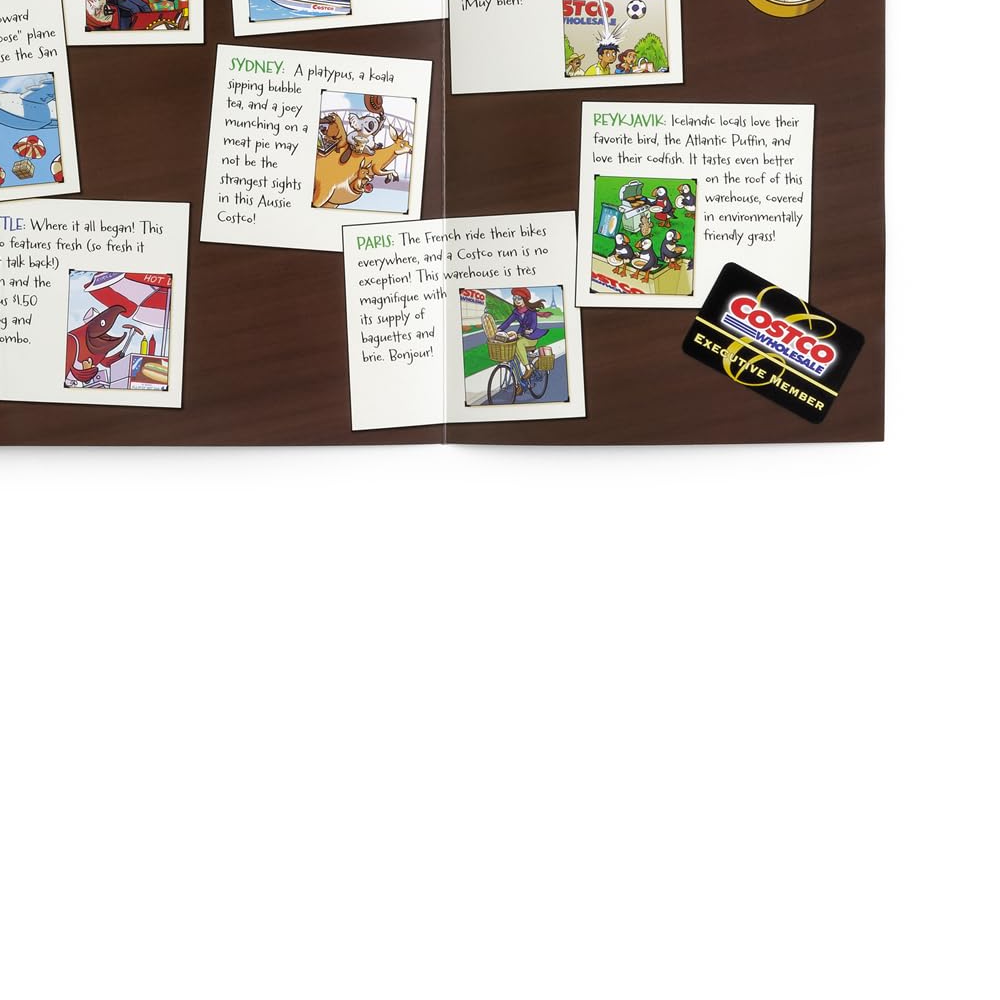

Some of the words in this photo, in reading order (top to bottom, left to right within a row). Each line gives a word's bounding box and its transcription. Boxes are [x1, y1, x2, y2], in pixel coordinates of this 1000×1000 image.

[228, 57, 285, 75] SYDNEY:
[293, 63, 304, 78] A
[307, 64, 355, 84] platypus,
[358, 71, 365, 81] a
[368, 67, 395, 84] koala
[593, 111, 667, 128] REYKJAVIK:
[671, 113, 716, 127] Icelandic
[719, 114, 747, 128] locals
[750, 115, 771, 128] love
[775, 114, 800, 128] their
[29, 217, 69, 232] Where
[71, 219, 81, 233] it
[83, 219, 96, 233] all
[100, 219, 135, 239] began!
[138, 220, 164, 235] This
[356, 234, 395, 251] PARIS:
[398, 231, 421, 247] The
[424, 228, 462, 244] French
[465, 227, 486, 241] ride
[489, 225, 517, 240] their
[519, 222, 547, 238] bikes
[703, 227, 745, 246] friendly
[747, 229, 776, 247] grass!
[730, 296, 836, 365] COSTCO
[361, 350, 385, 363] brie.
[388, 345, 434, 366] Bonjour!
[754, 331, 825, 375] WHOLESALE
[693, 333, 767, 380] EXECUTIVE
[769, 374, 826, 411] MEMBER
